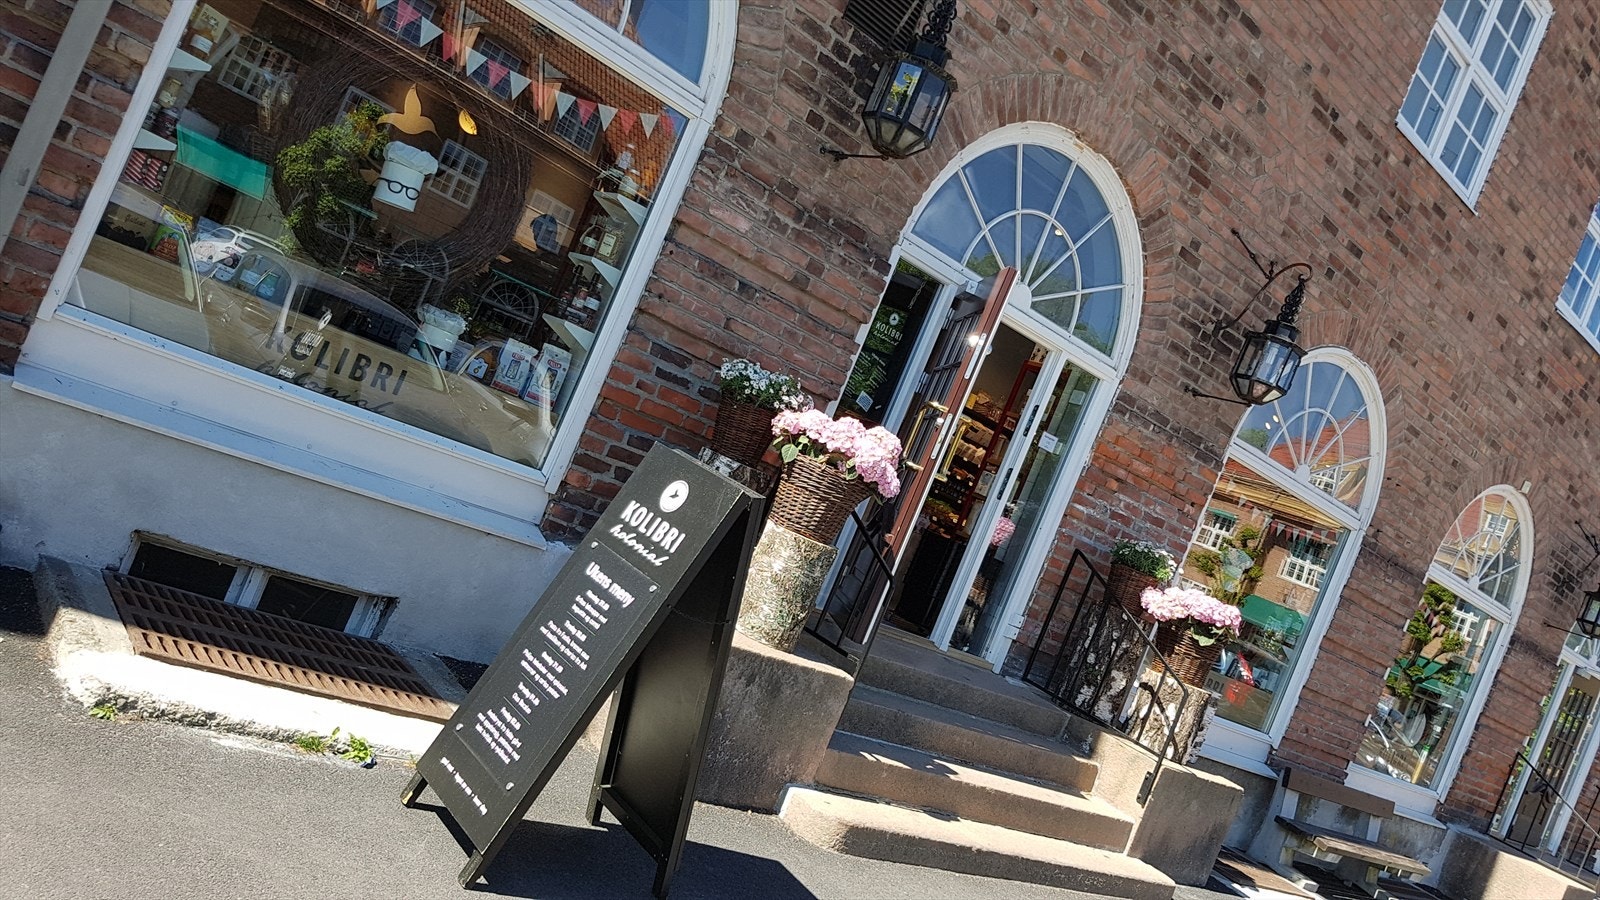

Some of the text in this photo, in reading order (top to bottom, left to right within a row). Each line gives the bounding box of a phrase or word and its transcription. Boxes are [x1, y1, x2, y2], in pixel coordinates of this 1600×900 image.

[875, 321, 903, 341] KOLIBRI
[265, 327, 408, 396] KOLIBRI
[609, 523, 669, 566] kolonial
[619, 500, 685, 553] KOLIBRI
[585, 561, 612, 589] Ukens
[608, 582, 635, 608] meny
